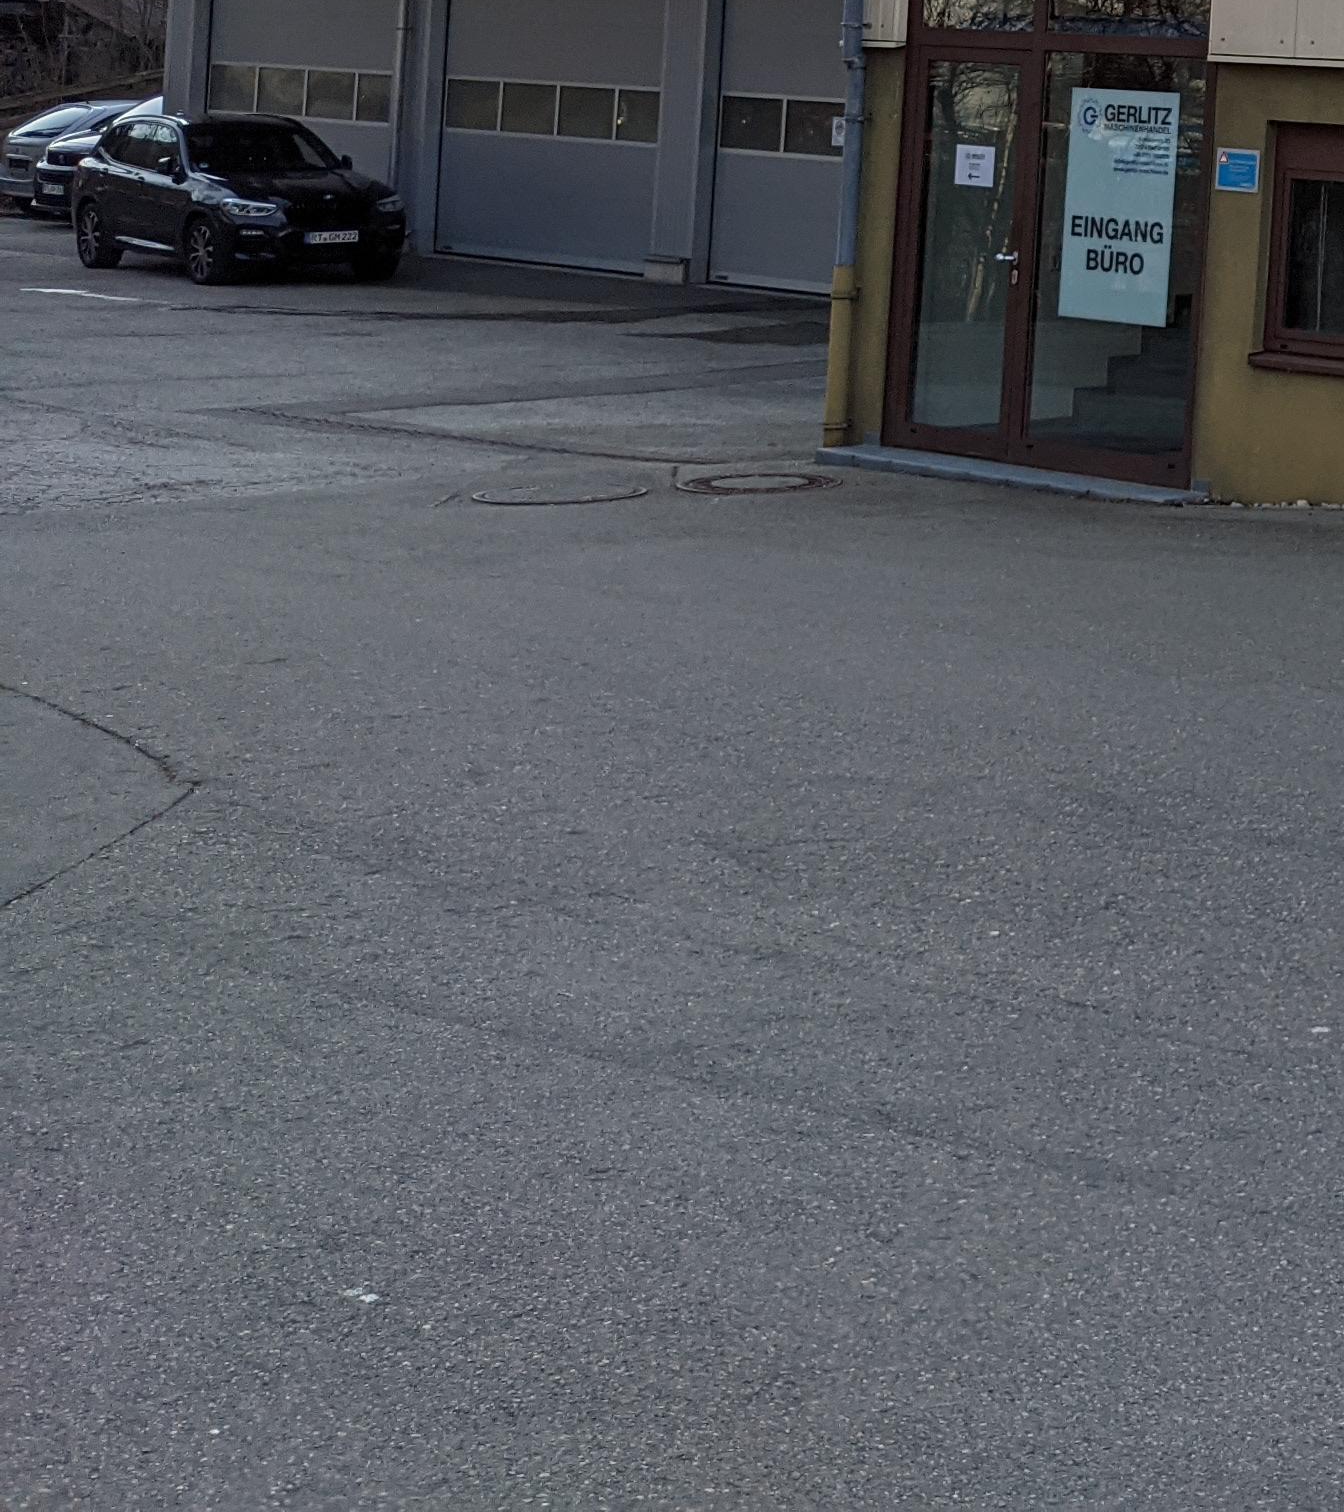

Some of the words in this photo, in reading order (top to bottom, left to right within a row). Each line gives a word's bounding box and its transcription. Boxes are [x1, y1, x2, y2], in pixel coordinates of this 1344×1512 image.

[1104, 104, 1172, 126] GERLITZ
[1071, 215, 1164, 244] EINGANG
[1086, 245, 1145, 275] BÜRO
